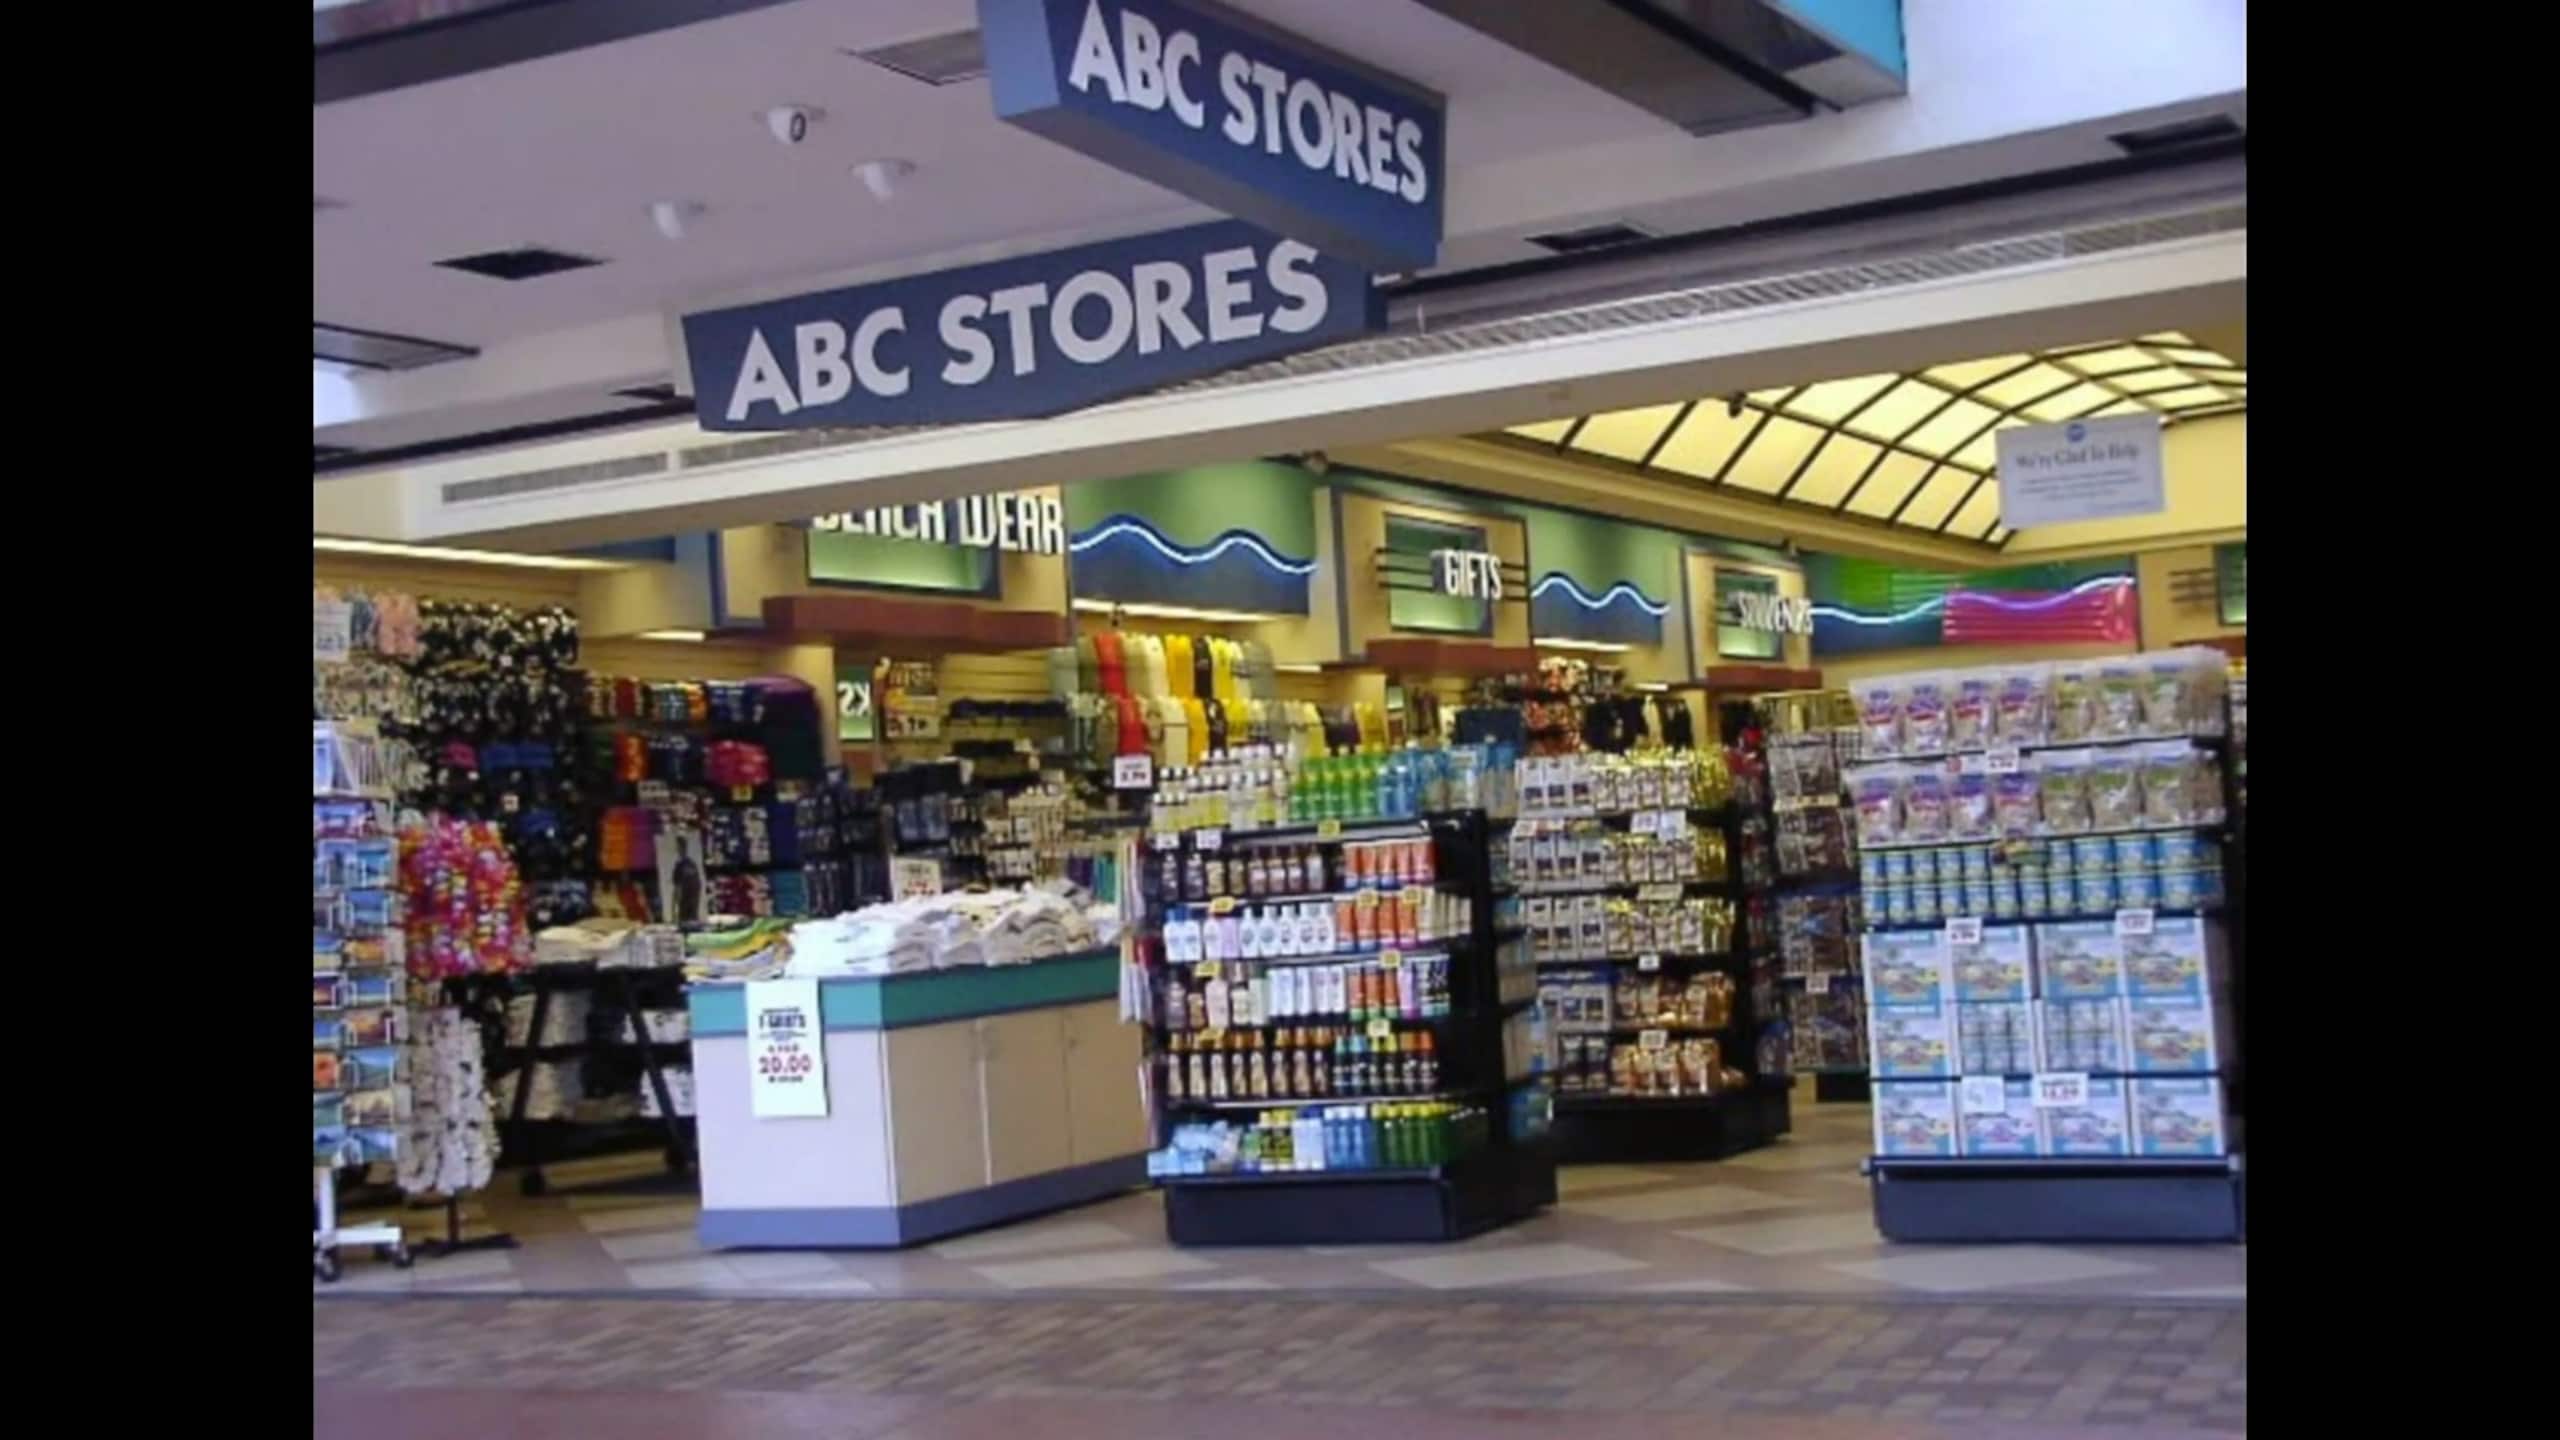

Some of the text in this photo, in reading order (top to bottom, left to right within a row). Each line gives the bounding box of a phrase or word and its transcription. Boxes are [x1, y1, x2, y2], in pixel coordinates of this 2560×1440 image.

[1069, 0, 1428, 204] ABC STORES
[726, 240, 1329, 422] ABC STORES
[957, 489, 1065, 555] WEAR
[1445, 549, 1503, 600] GIFTS
[758, 1054, 813, 1075] 20.00
